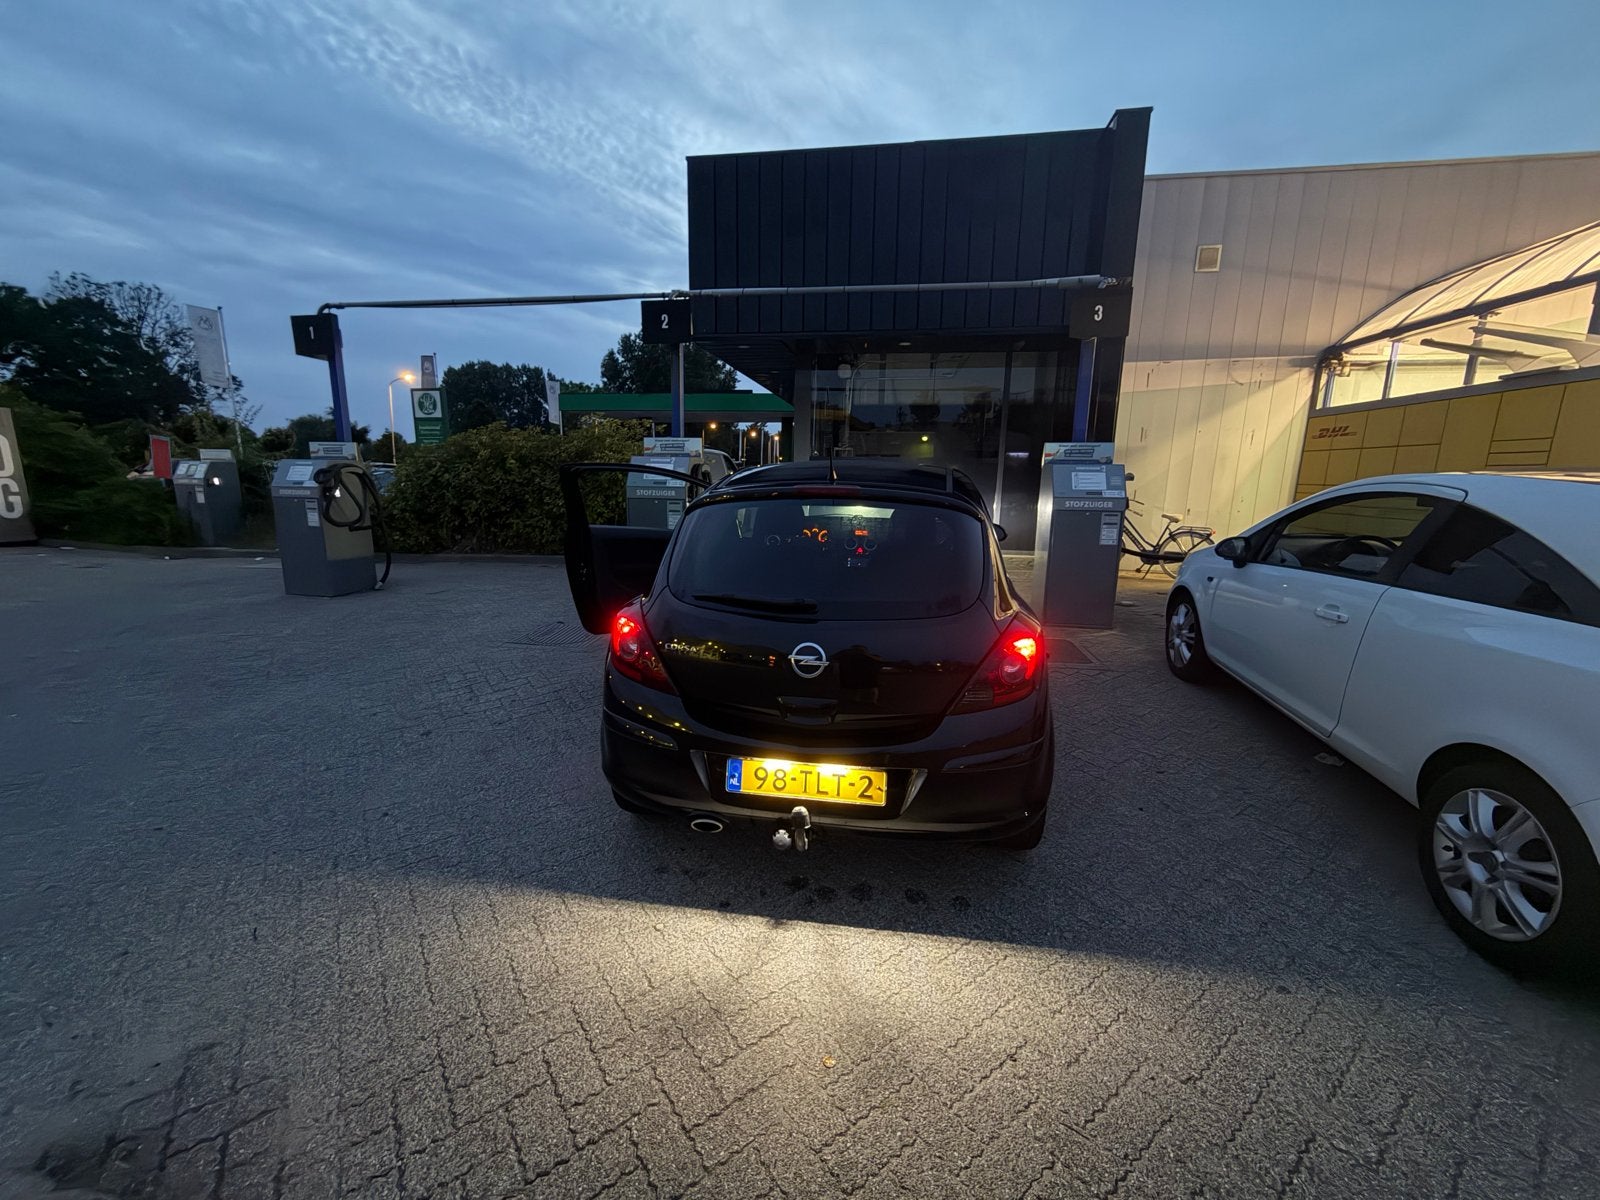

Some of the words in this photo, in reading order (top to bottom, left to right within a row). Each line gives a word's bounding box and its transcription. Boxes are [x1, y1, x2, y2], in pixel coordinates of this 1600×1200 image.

[1094, 304, 1103, 321] 3
[661, 313, 669, 329] 2
[309, 326, 315, 340] 1
[1313, 425, 1353, 439] DHL
[635, 489, 676, 497] STOFZUIGER
[665, 642, 698, 653] CORSA
[729, 777, 740, 786] NL
[754, 766, 874, 800] 98-TLT-2
